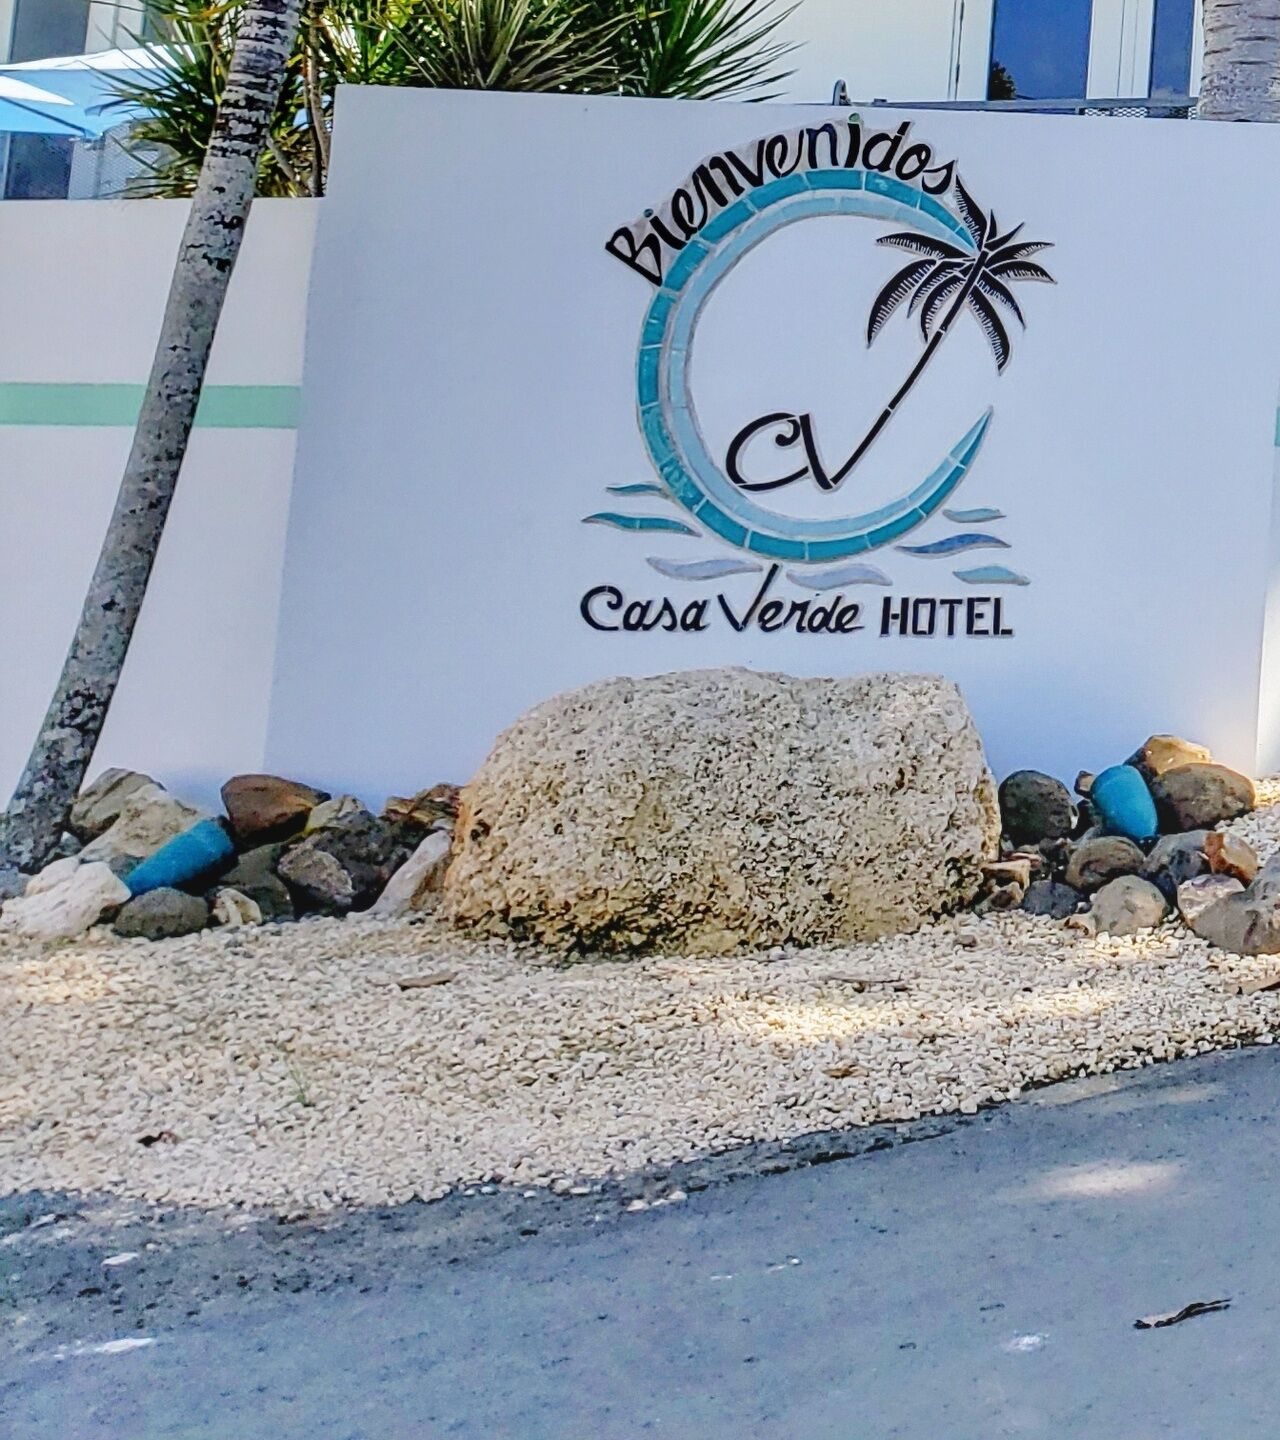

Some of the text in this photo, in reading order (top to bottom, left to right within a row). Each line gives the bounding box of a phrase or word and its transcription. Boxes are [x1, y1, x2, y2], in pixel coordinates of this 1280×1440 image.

[604, 113, 958, 287] Bienvenidos
[580, 563, 1014, 637] Casa Verde HOTEL
